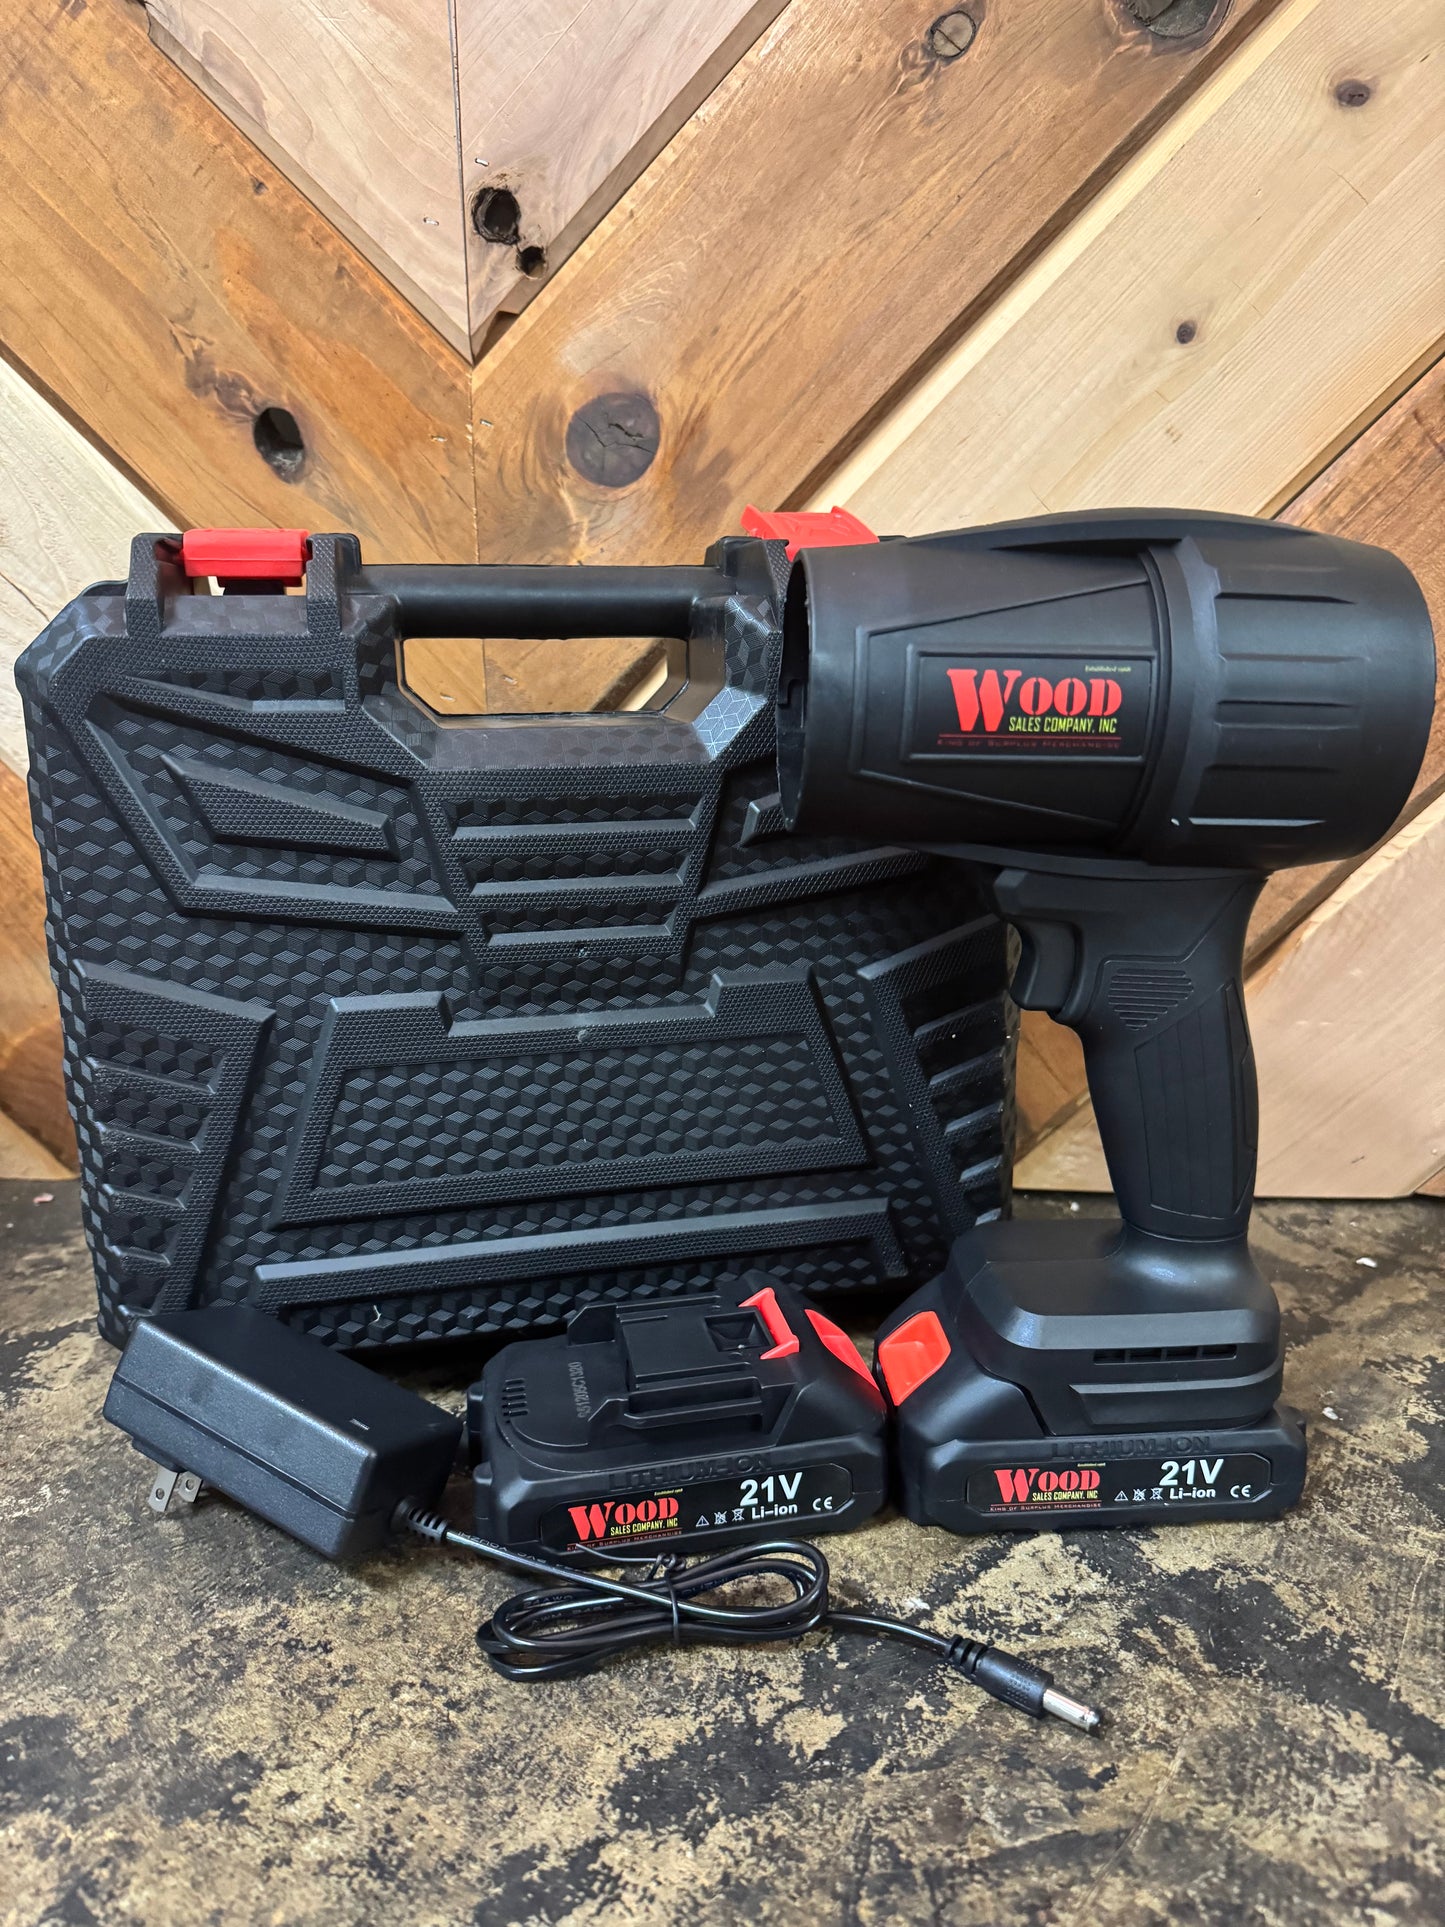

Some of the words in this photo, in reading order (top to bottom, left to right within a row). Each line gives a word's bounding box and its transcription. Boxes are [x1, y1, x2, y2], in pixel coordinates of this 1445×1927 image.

[1008, 716, 1040, 733] SALES
[1098, 718, 1118, 734] INC
[1159, 1458, 1224, 1487] 21V
[739, 1471, 803, 1507] 21V
[1032, 1492, 1052, 1502] SALES
[1086, 1490, 1098, 1499] INC
[1169, 1487, 1216, 1500] Li-ion
[751, 1503, 798, 1520] Li-ion
[610, 1526, 631, 1536] SALES
[666, 1517, 678, 1527] INC
